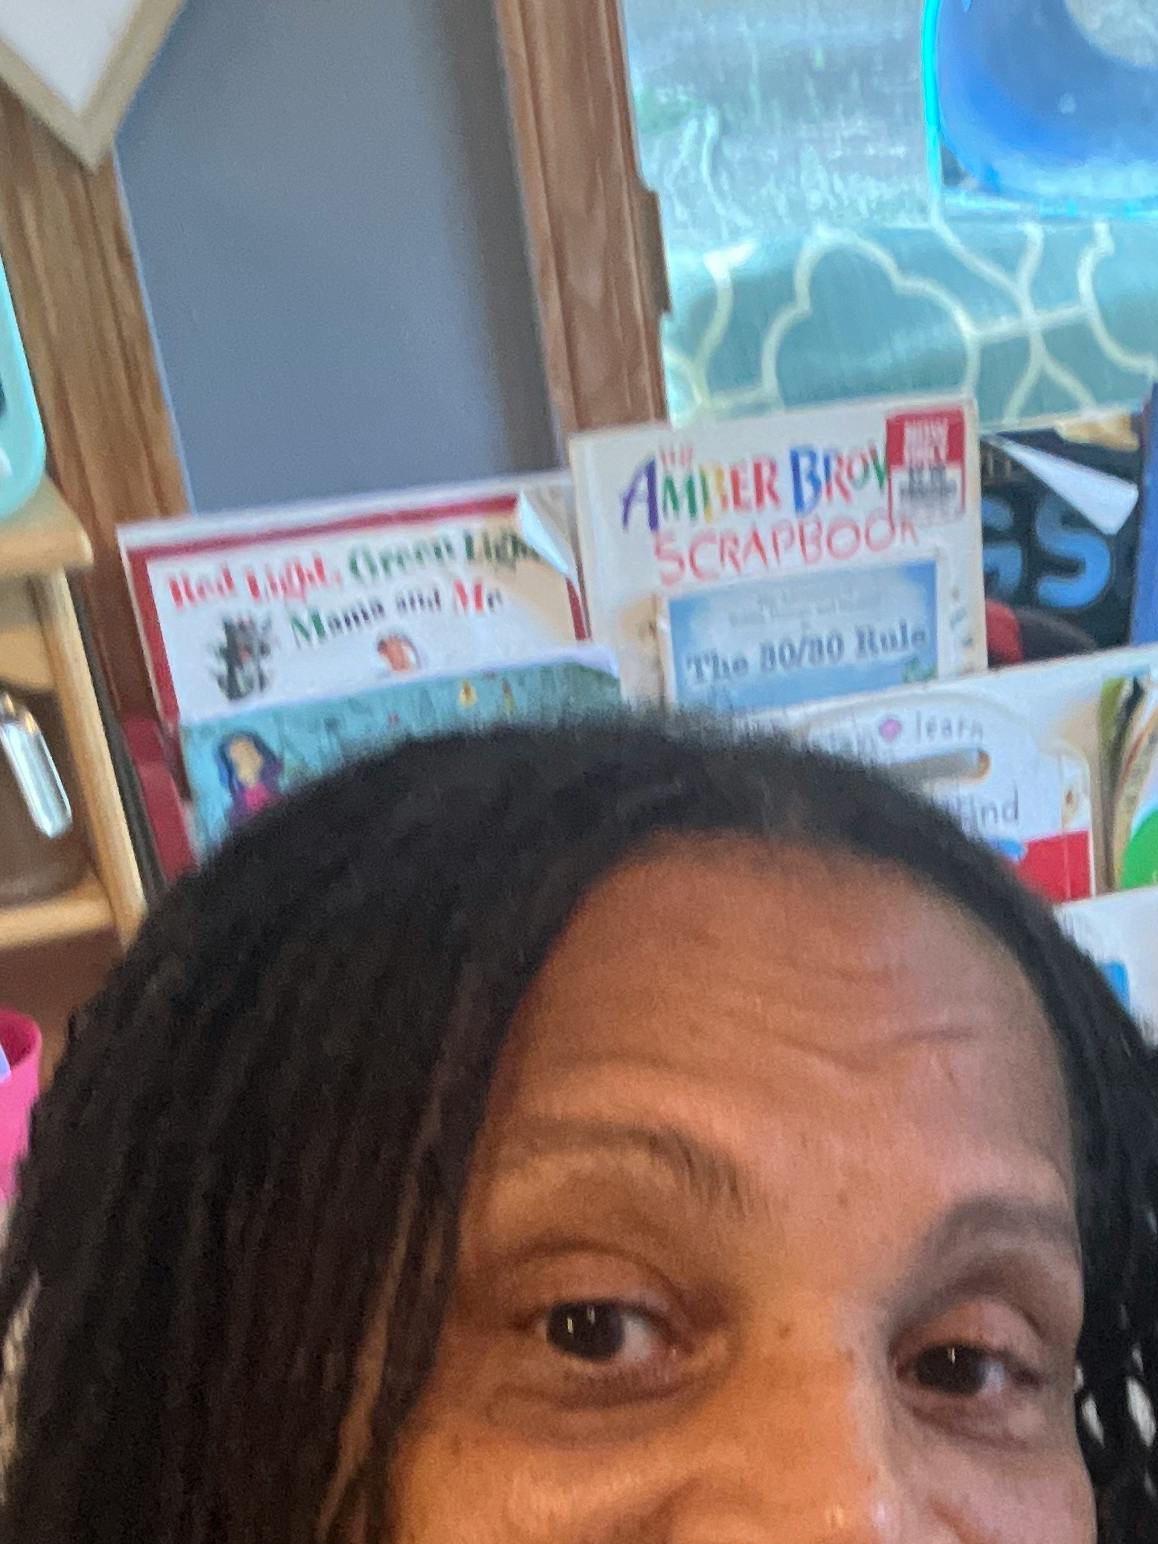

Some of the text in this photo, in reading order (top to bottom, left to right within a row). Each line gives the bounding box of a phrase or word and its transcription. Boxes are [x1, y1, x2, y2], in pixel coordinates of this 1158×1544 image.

[620, 454, 782, 534] AMBER
[168, 562, 234, 612] Red
[397, 586, 441, 613] and
[453, 576, 503, 615] Me
[684, 651, 749, 686] The
[855, 620, 928, 660] Rule
[916, 712, 984, 744] learn
